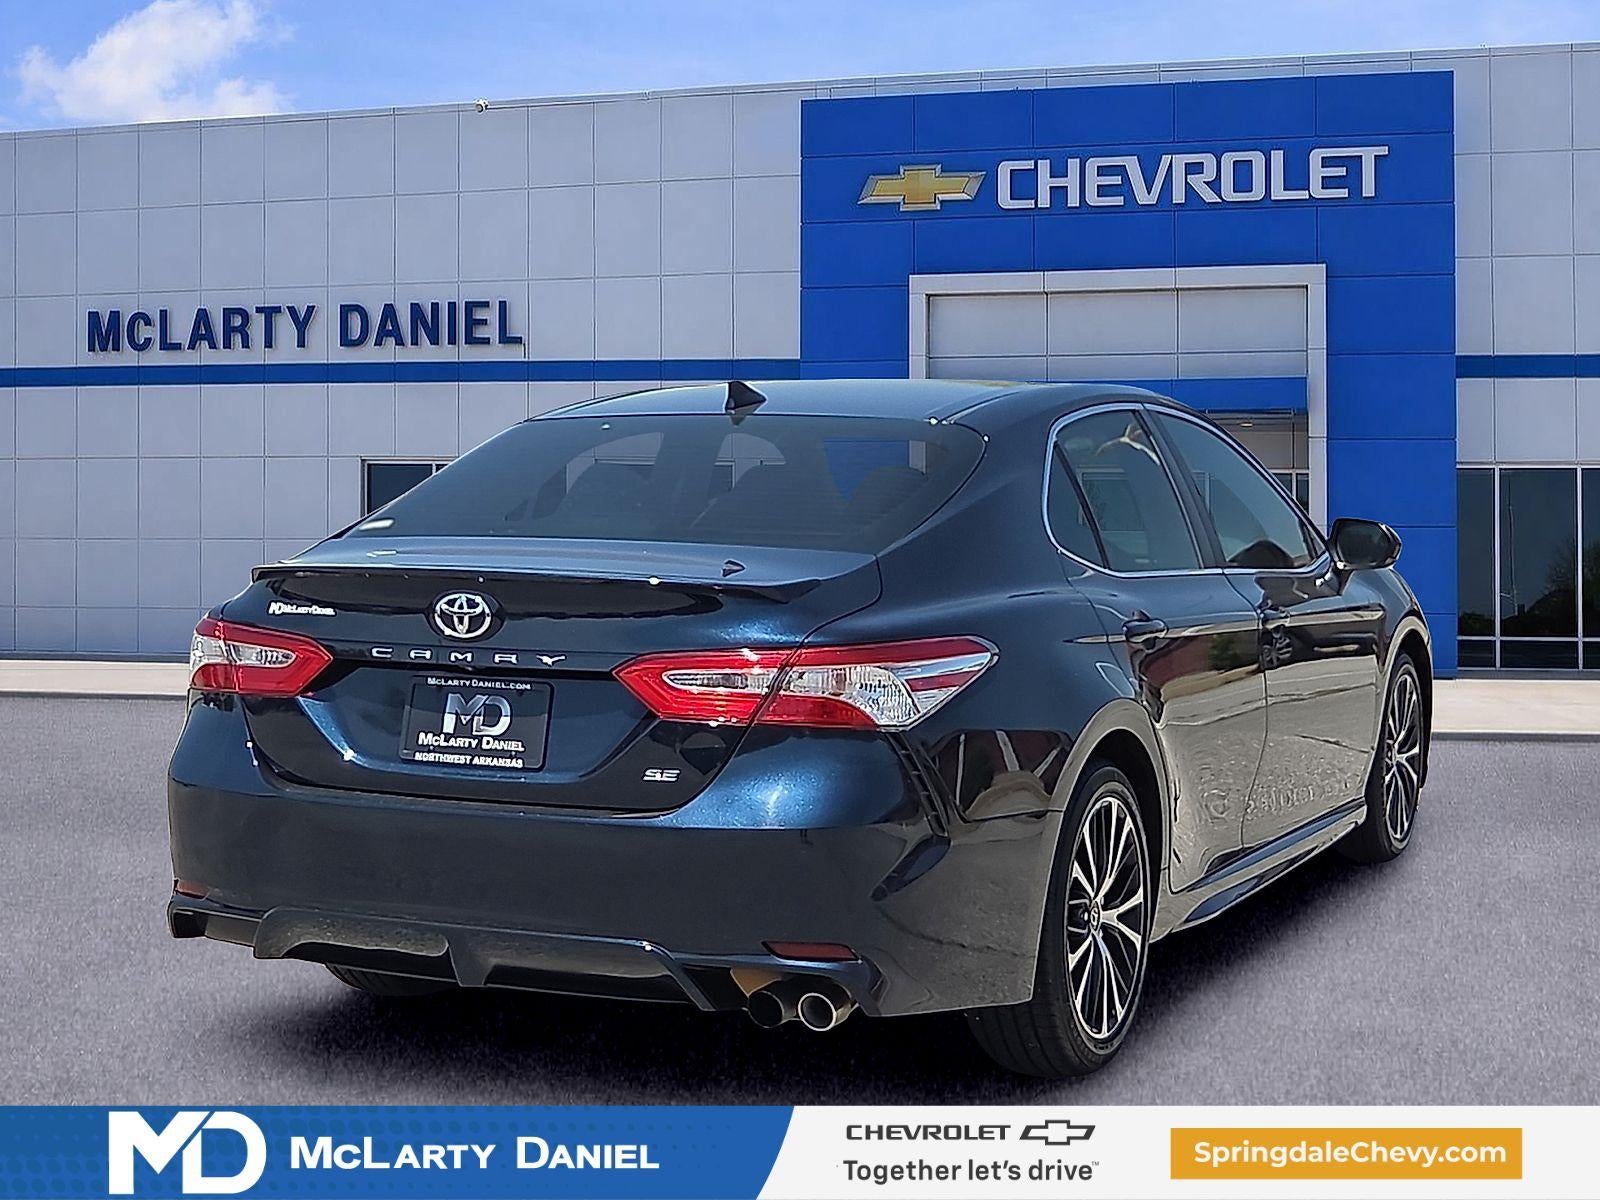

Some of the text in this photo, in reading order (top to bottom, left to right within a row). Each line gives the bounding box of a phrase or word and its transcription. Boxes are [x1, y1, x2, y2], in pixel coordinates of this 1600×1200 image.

[996, 145, 1389, 211] CHEVROLET
[338, 299, 523, 348] DANIEL
[371, 646, 566, 666] CAMRY
[442, 693, 511, 736] MD
[481, 736, 525, 752] DANIEL
[414, 752, 524, 769] NORTHWEST ARKANSAS
[642, 768, 681, 782] SE
